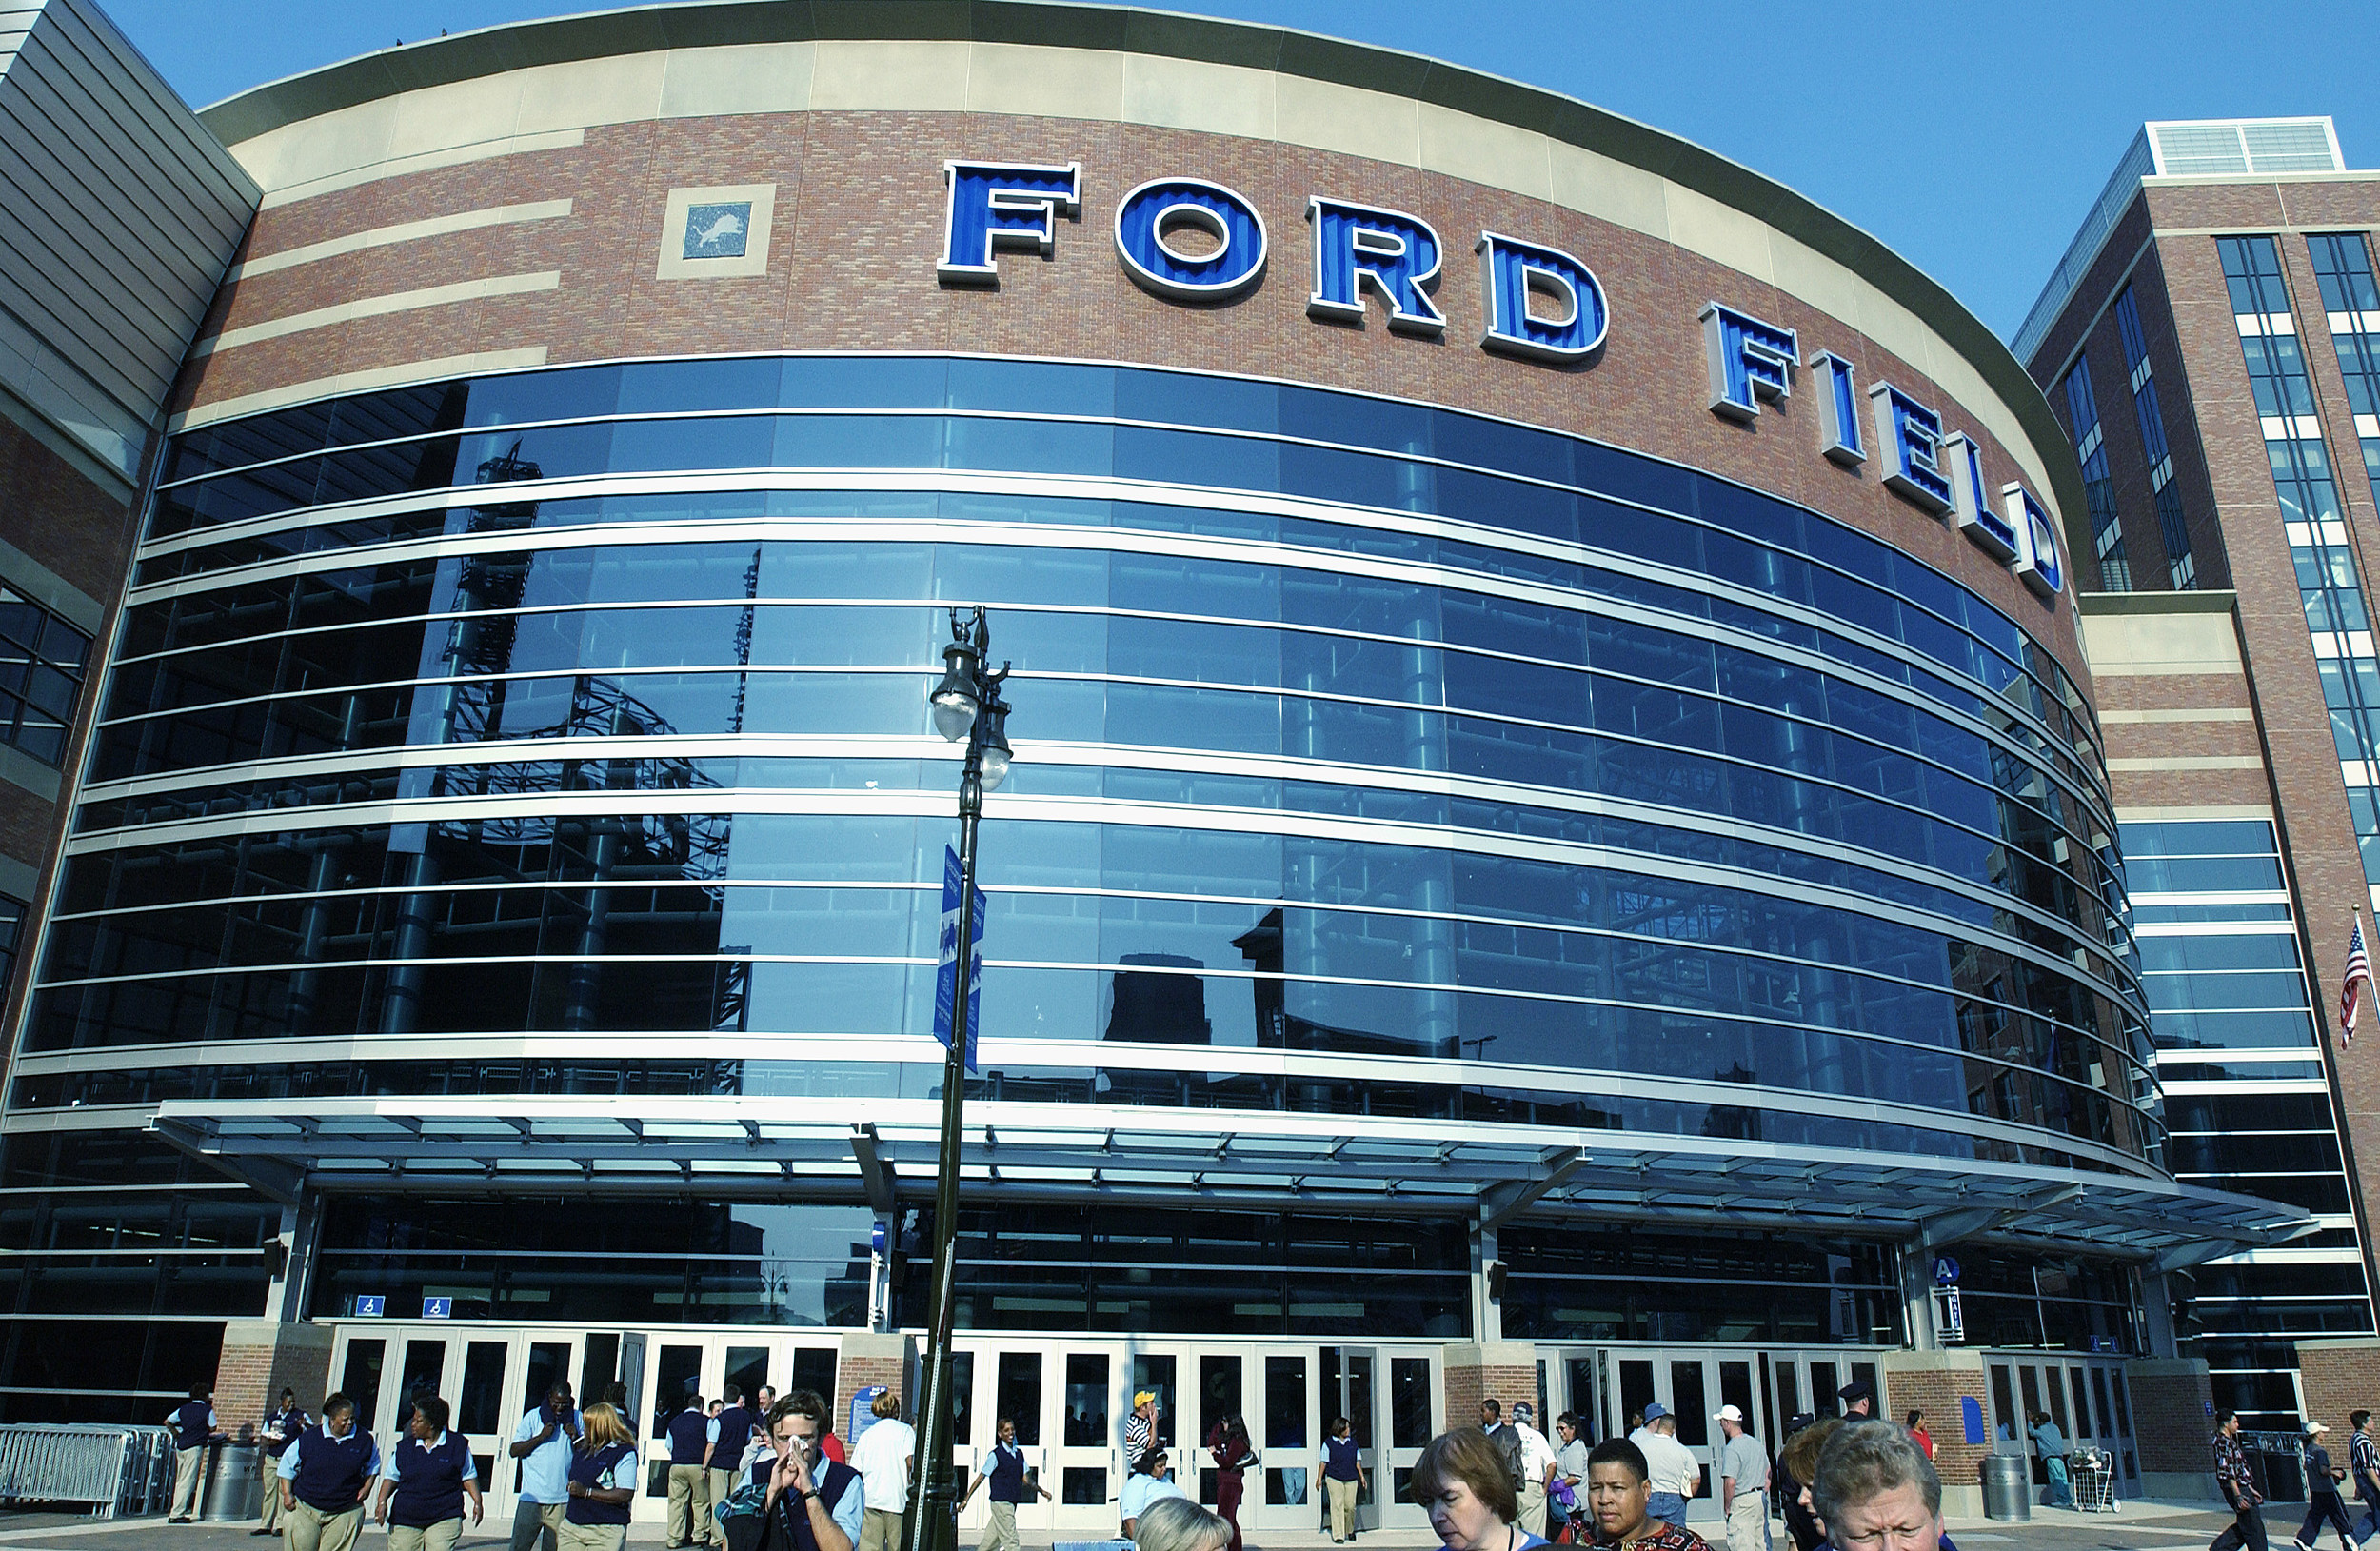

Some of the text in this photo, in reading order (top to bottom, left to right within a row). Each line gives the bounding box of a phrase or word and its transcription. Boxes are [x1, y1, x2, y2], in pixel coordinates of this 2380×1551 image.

[937, 159, 2064, 597] FORD FIELD
[1936, 1259, 1952, 1278] A
[1951, 1295, 1960, 1327] GATE
